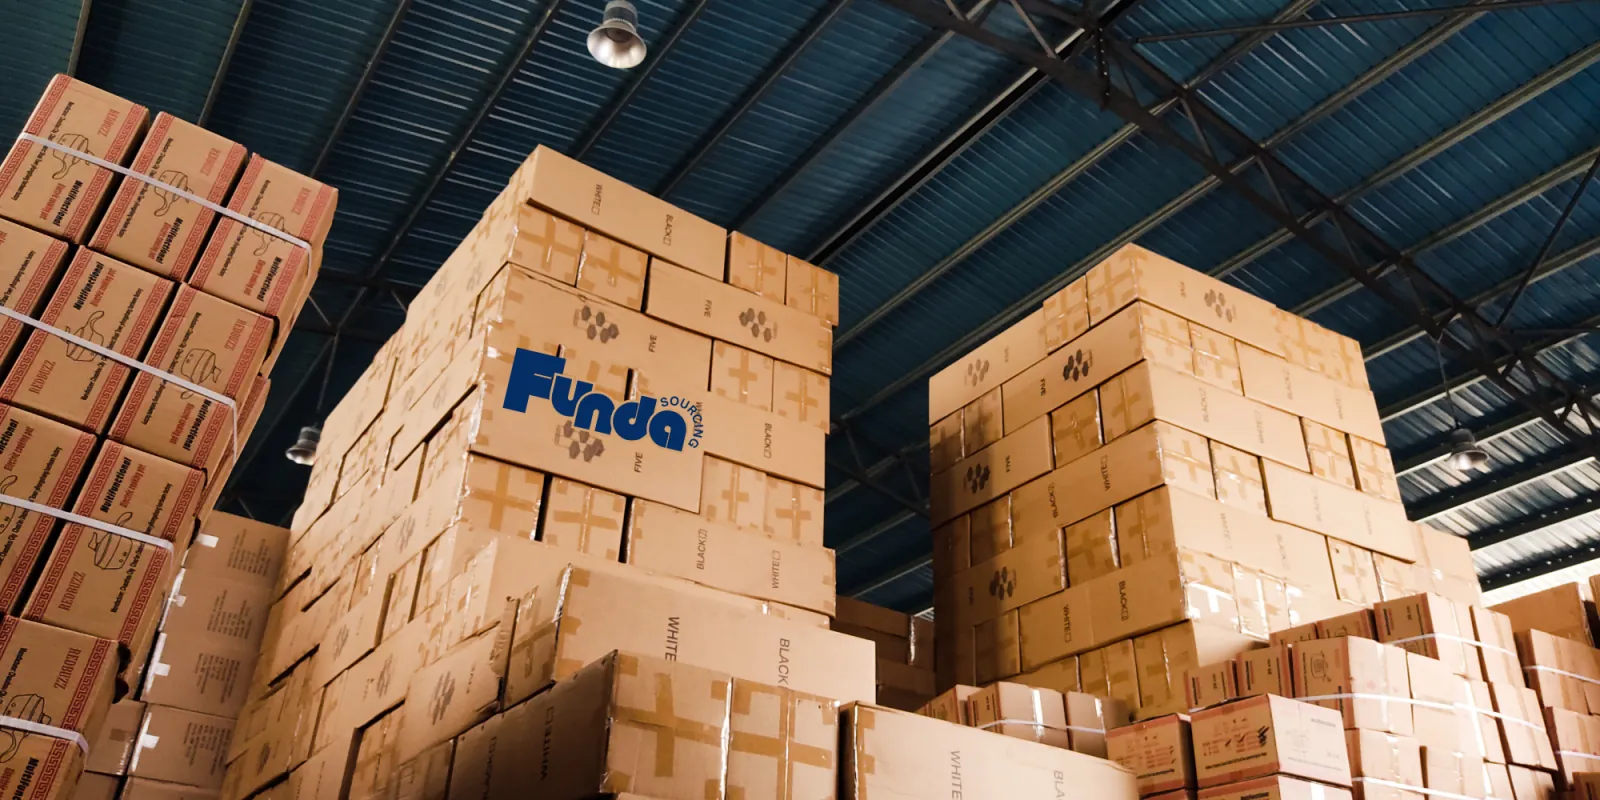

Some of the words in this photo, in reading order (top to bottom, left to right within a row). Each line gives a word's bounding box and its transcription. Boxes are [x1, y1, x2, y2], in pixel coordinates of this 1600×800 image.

[53, 180, 83, 226] Multifunctional
[592, 184, 603, 206] WHITE
[156, 218, 183, 264] Multifunctional
[664, 214, 674, 236] BLACK
[73, 262, 104, 310] Multifunctional
[257, 257, 282, 302] Multifunctional
[704, 299, 712, 317] FIVE
[648, 334, 657, 353] FIVE
[28, 360, 56, 394] REDBUZZ
[183, 399, 212, 451] Multifunctional
[764, 422, 772, 449] BLACK
[634, 451, 643, 473] FIVE
[100, 457, 131, 513] Multifunctional
[696, 538, 706, 570] BLACK
[58, 572, 85, 611] REDBUZZ
[771, 561, 780, 589] WHITE
[1118, 580, 1127, 610] BLACK
[665, 616, 680, 662] WHITE
[54, 648, 81, 690] REDBUZZ
[778, 638, 789, 685] BLACK
[12, 758, 39, 800] Multifunc
[950, 750, 962, 800] WHITE
[1053, 770, 1065, 800] BLA
